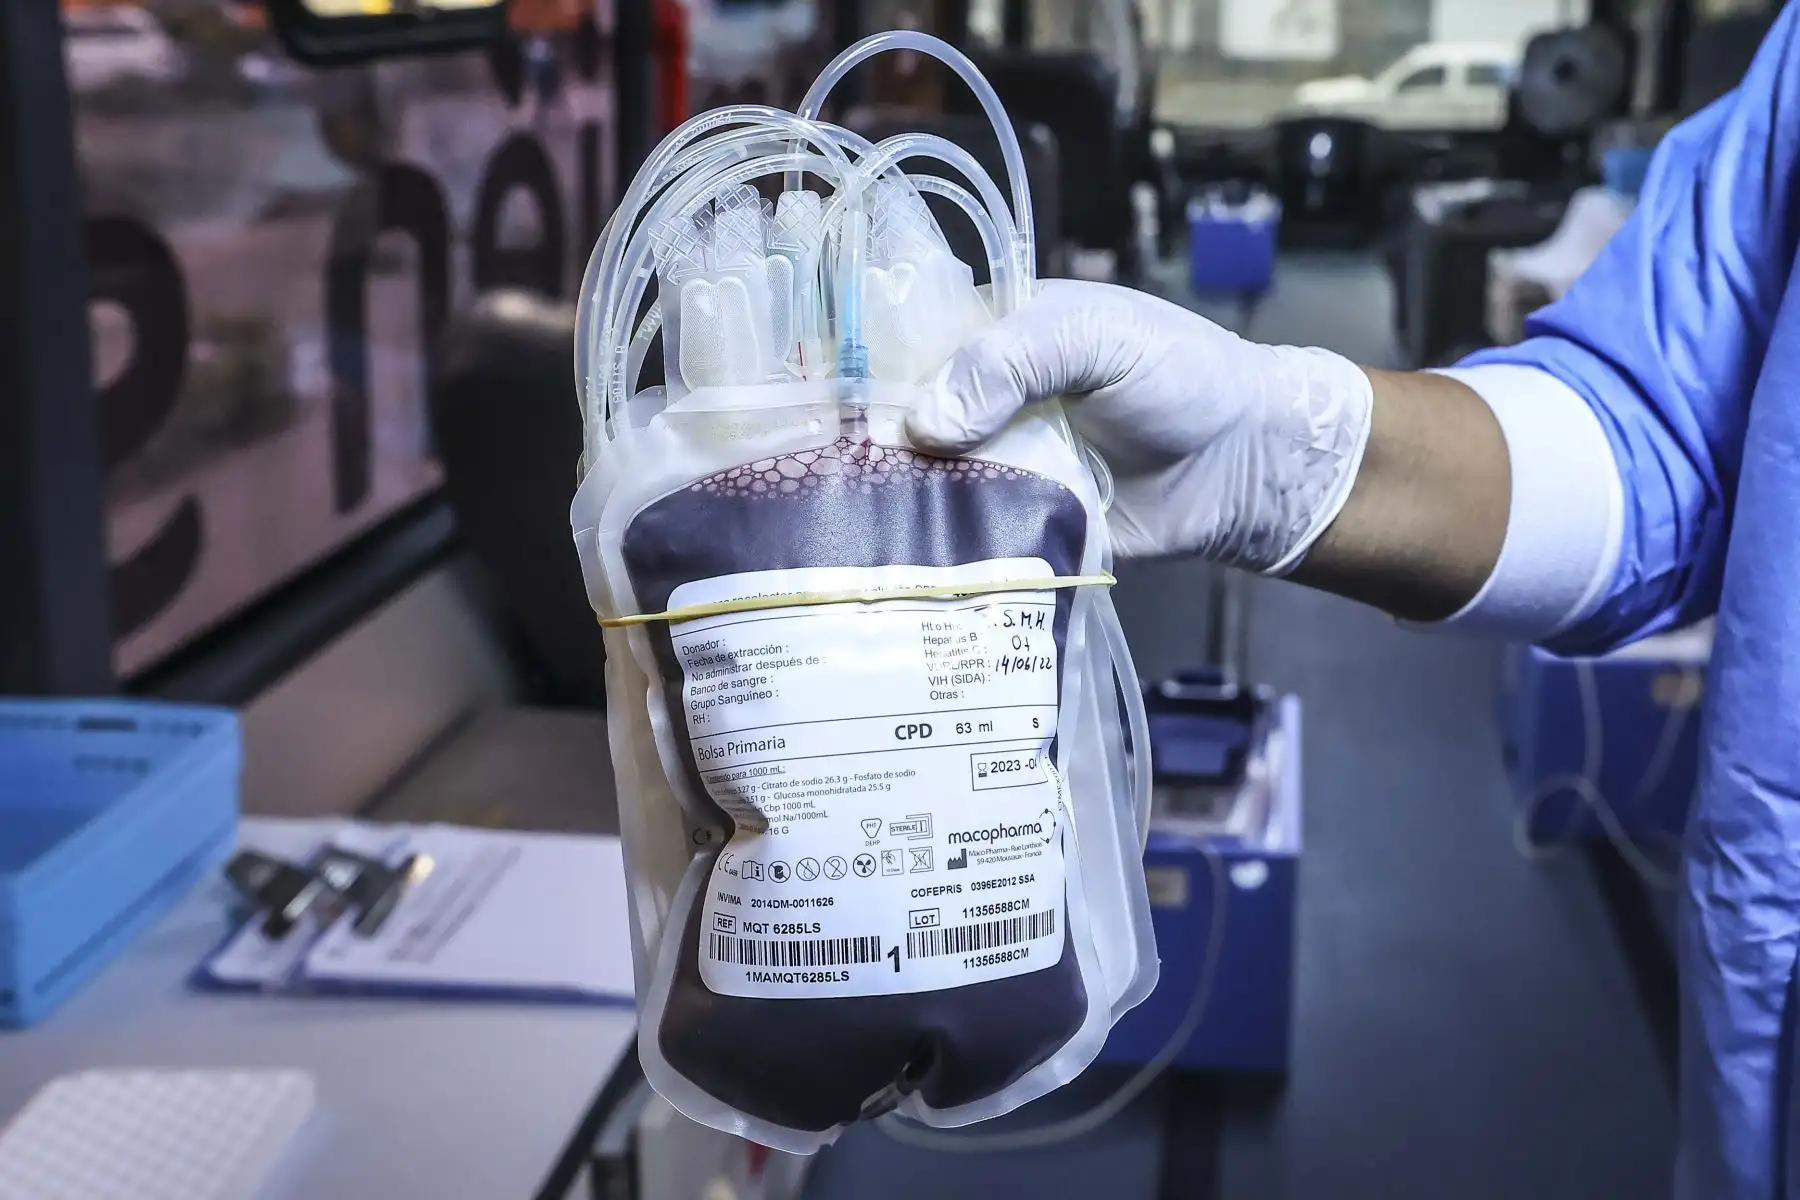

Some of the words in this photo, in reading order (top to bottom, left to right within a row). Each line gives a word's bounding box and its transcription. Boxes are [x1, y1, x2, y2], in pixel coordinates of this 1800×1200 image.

[969, 632, 978, 642] B
[682, 639, 719, 656] Donador
[687, 655, 714, 669] Fecha
[715, 651, 726, 663] de
[727, 644, 782, 660] extracción
[995, 655, 1052, 675] 14/06/22
[691, 672, 703, 682] No
[705, 661, 752, 681] administrar
[755, 657, 803, 672] después
[805, 655, 820, 665] de
[690, 685, 716, 697] Banco
[717, 680, 729, 691] de
[731, 676, 767, 690] sangre
[928, 676, 948, 687] VIH
[951, 673, 986, 688] (SIDA)
[690, 698, 716, 713] Grupo
[718, 689, 773, 706] Sanguíneo
[929, 690, 959, 701] Otras
[894, 723, 933, 741] CPD
[955, 722, 972, 735] 63
[978, 721, 993, 733] ml
[1032, 717, 1040, 729] S
[698, 743, 725, 761] Bolsa
[727, 736, 786, 758] Primaria
[732, 770, 747, 781] para
[748, 766, 768, 777] 1000
[990, 760, 1021, 774] 2023
[761, 779, 788, 791] Citrato
[789, 778, 800, 788] de
[801, 775, 823, 787] sodio
[825, 773, 842, 785] 26.3
[843, 775, 848, 785] g
[854, 770, 883, 782] Fosfato
[884, 769, 894, 779] de
[895, 767, 916, 780] sodio
[773, 789, 805, 801] Glucosa
[806, 783, 867, 799] monohidratada
[868, 782, 884, 793] 25.5
[885, 784, 891, 793] g
[782, 801, 801, 811] 1000
[804, 800, 816, 810] mL
[769, 827, 779, 836] 16
[890, 824, 916, 833] STERILE
[948, 822, 1042, 845] macopharma
[986, 846, 1008, 856] Pharma
[910, 883, 962, 898] COFEPRIS
[970, 876, 1017, 891] 0396E2012
[1018, 873, 1035, 885] SSA
[717, 892, 742, 906] INVIMA
[751, 896, 834, 909] 2014DM-0011626
[962, 898, 1030, 918] 11356588CM
[717, 917, 733, 929] REF
[743, 922, 769, 935] MQT
[773, 922, 821, 935] 6285LS
[914, 914, 935, 926] LOT
[887, 945, 900, 973] 1
[963, 947, 1029, 969] 11356588CM
[745, 971, 850, 983] 1MAMQT6285LS
